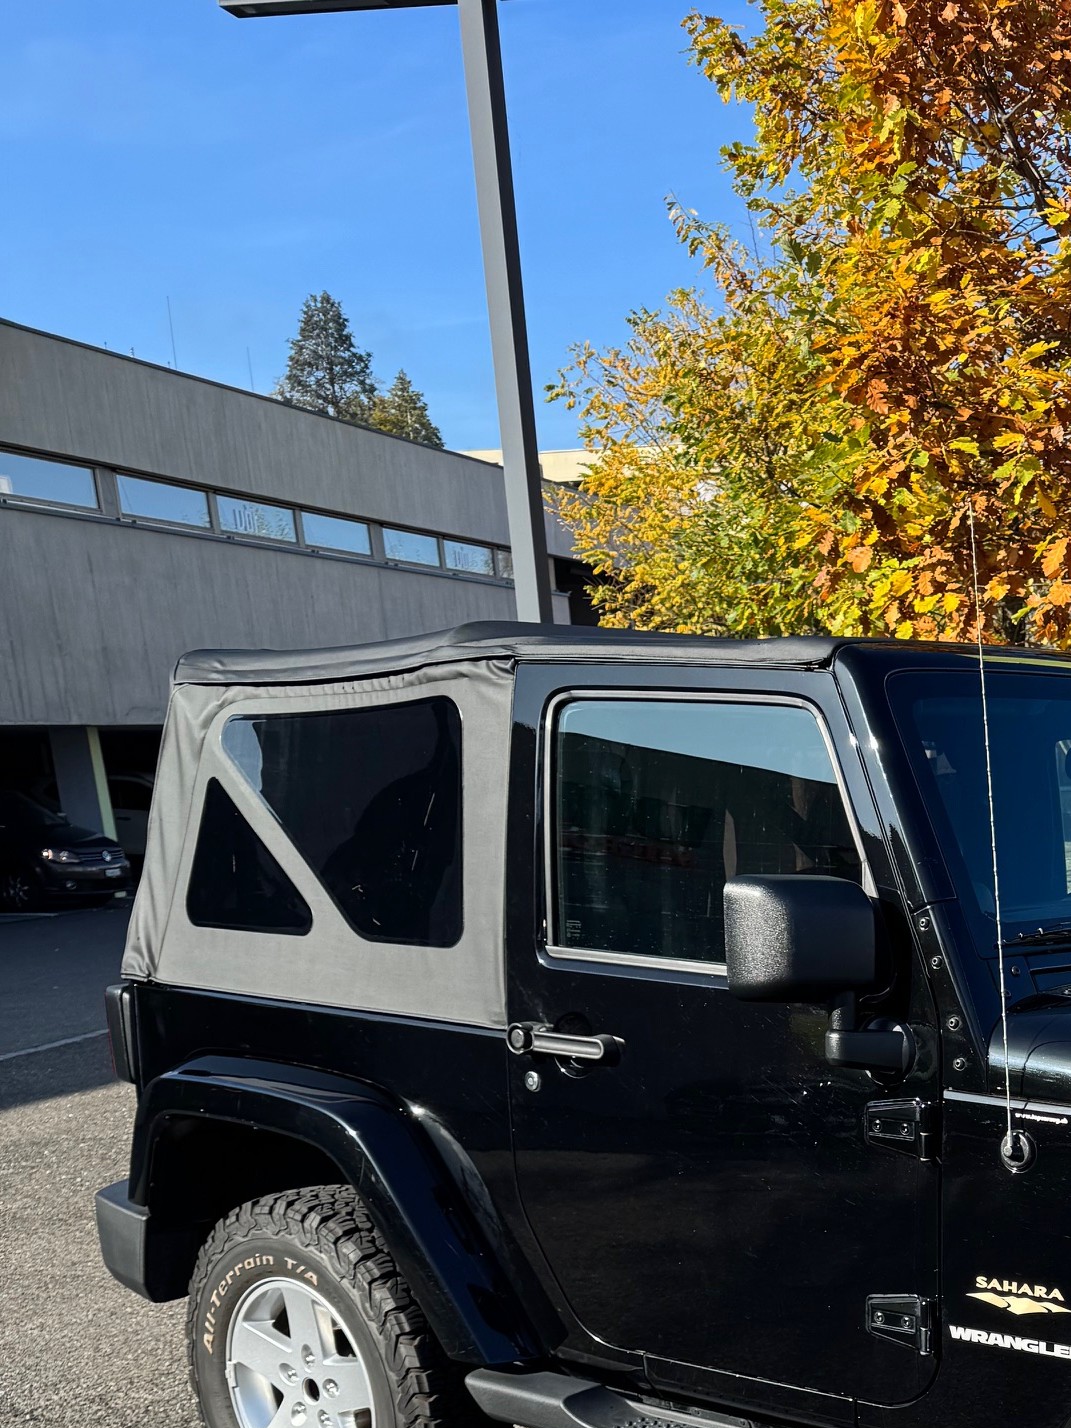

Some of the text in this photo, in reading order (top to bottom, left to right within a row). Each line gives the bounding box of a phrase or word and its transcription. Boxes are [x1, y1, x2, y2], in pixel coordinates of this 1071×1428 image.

[203, 1253, 318, 1355] All-Terrain T/A
[975, 1276, 1065, 1301] SAHARA
